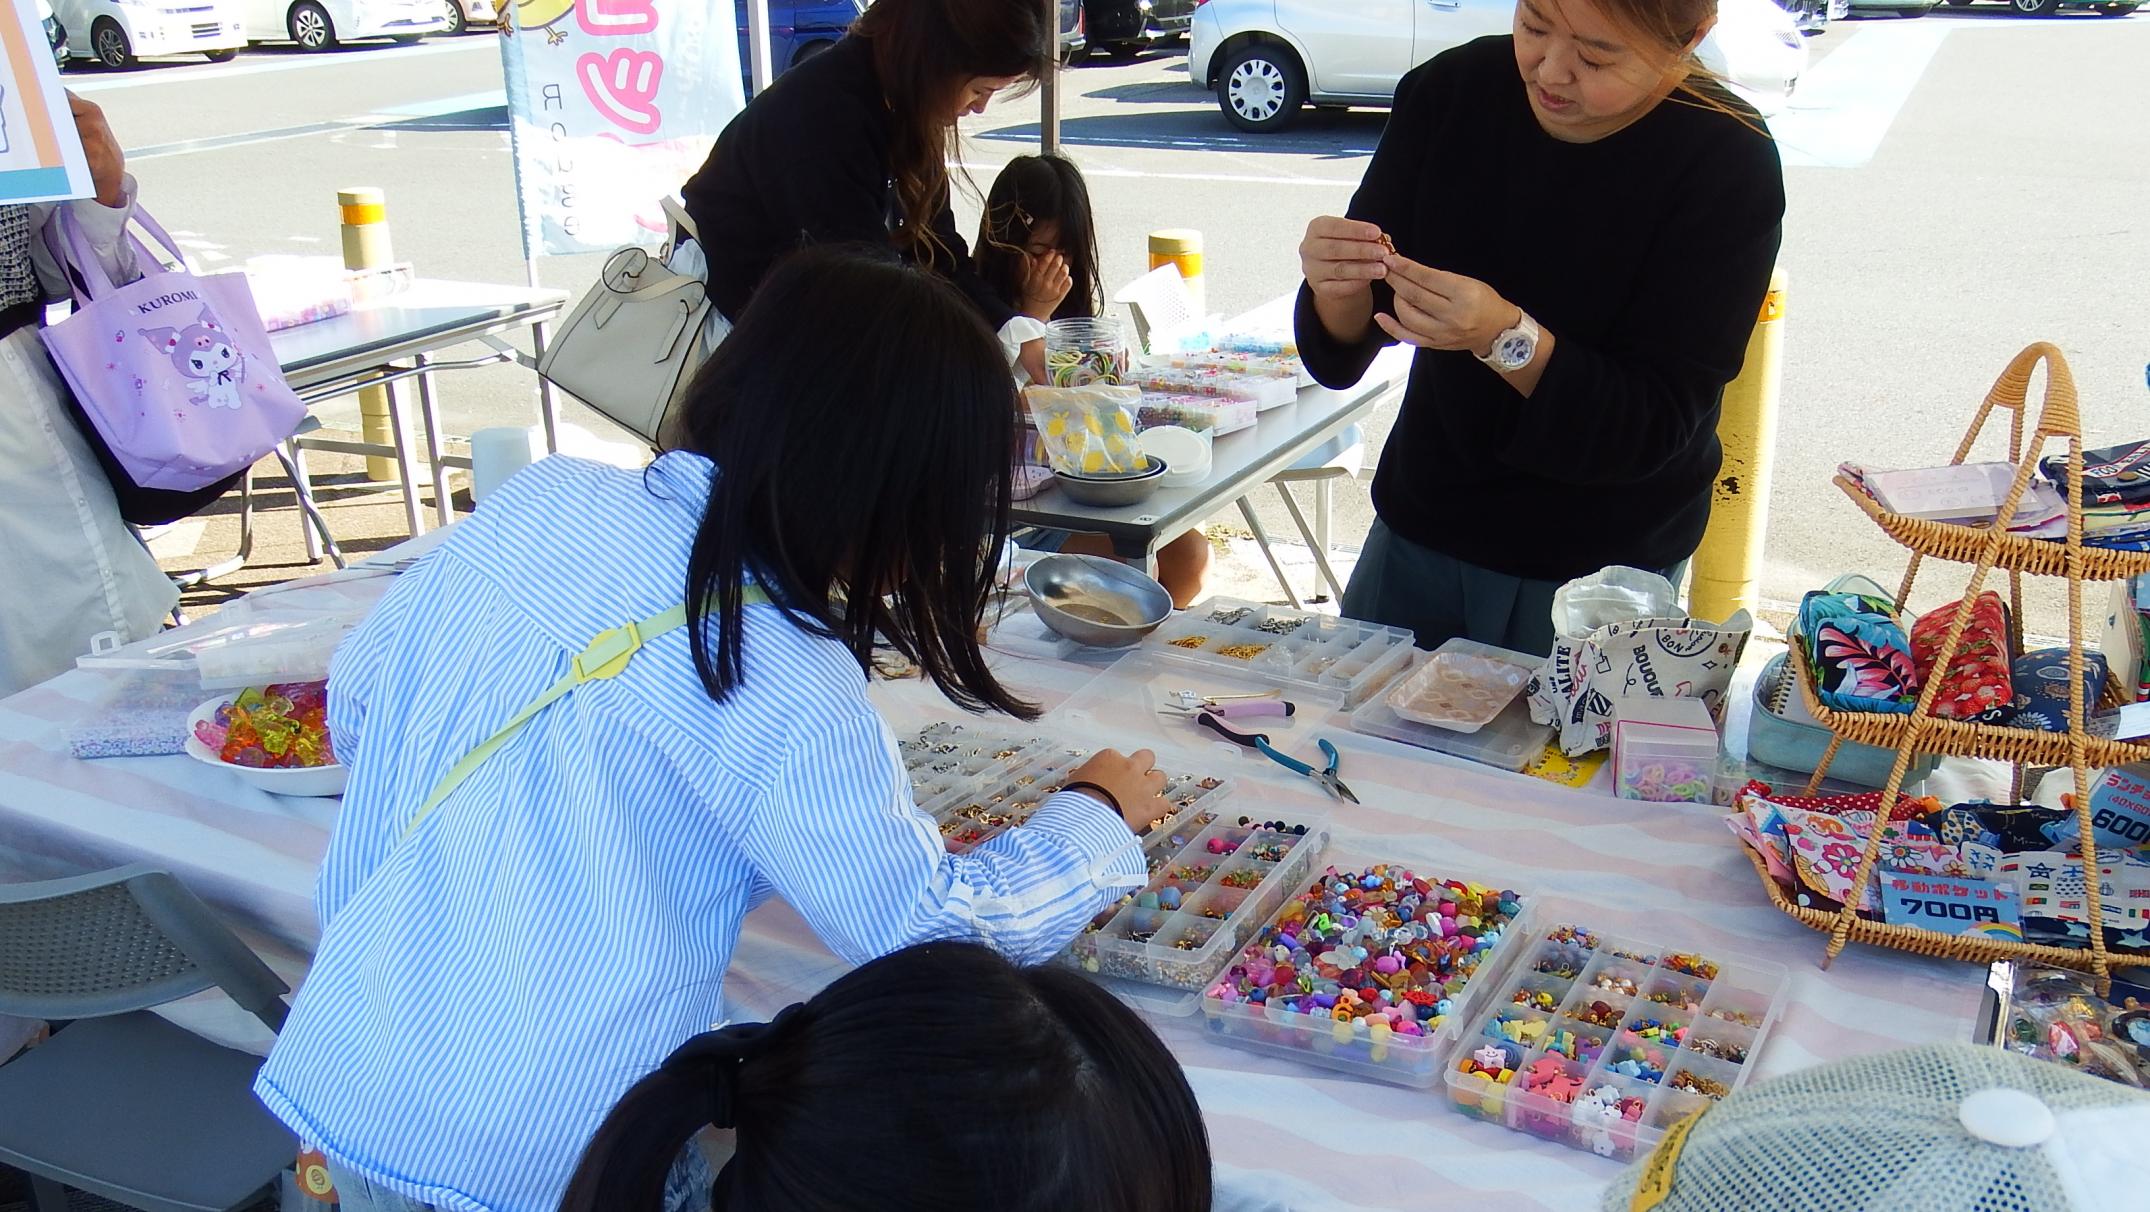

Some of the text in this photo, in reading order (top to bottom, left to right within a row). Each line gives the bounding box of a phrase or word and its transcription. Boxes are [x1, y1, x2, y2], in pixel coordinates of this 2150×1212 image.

[137, 290, 199, 314] KUROMI
[1661, 634, 1684, 653] BON
[2092, 808, 2150, 845] 600
[1900, 898, 2000, 924] 700円
